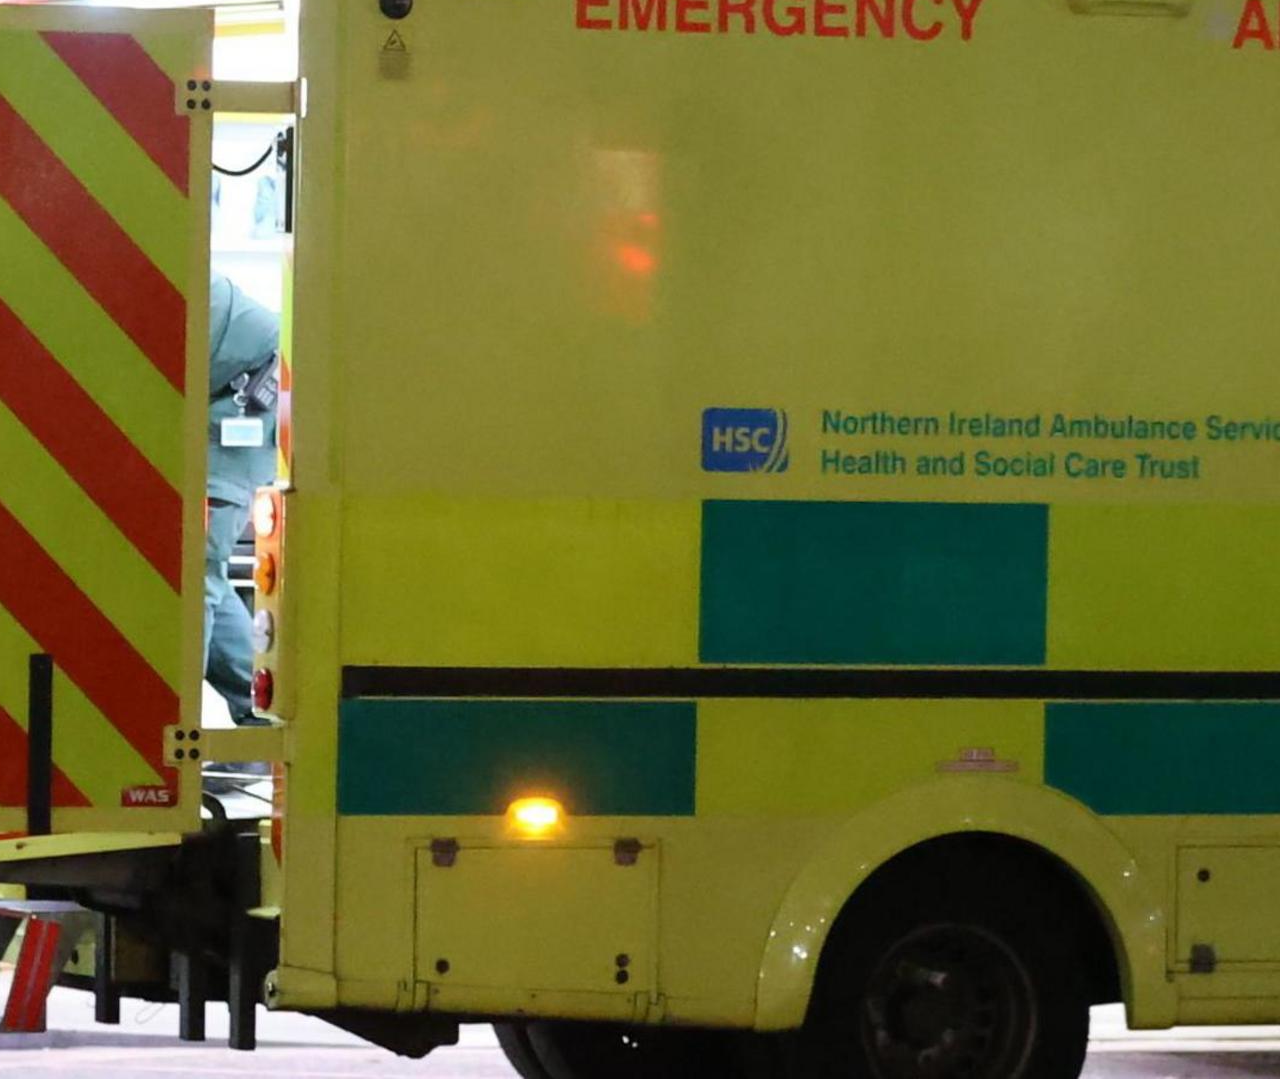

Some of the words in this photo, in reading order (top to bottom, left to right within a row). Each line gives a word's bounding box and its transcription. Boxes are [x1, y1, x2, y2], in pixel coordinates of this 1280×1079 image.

[822, 409, 939, 436] Northern
[949, 412, 1041, 438] Ireland
[1049, 413, 1198, 441] Ambulance
[712, 426, 770, 454] HSC
[821, 449, 907, 475] Health
[916, 452, 965, 476] and
[974, 450, 1055, 477] Social
[1064, 451, 1127, 478] Care
[1135, 453, 1202, 480] Trust
[128, 788, 170, 802] WAS
